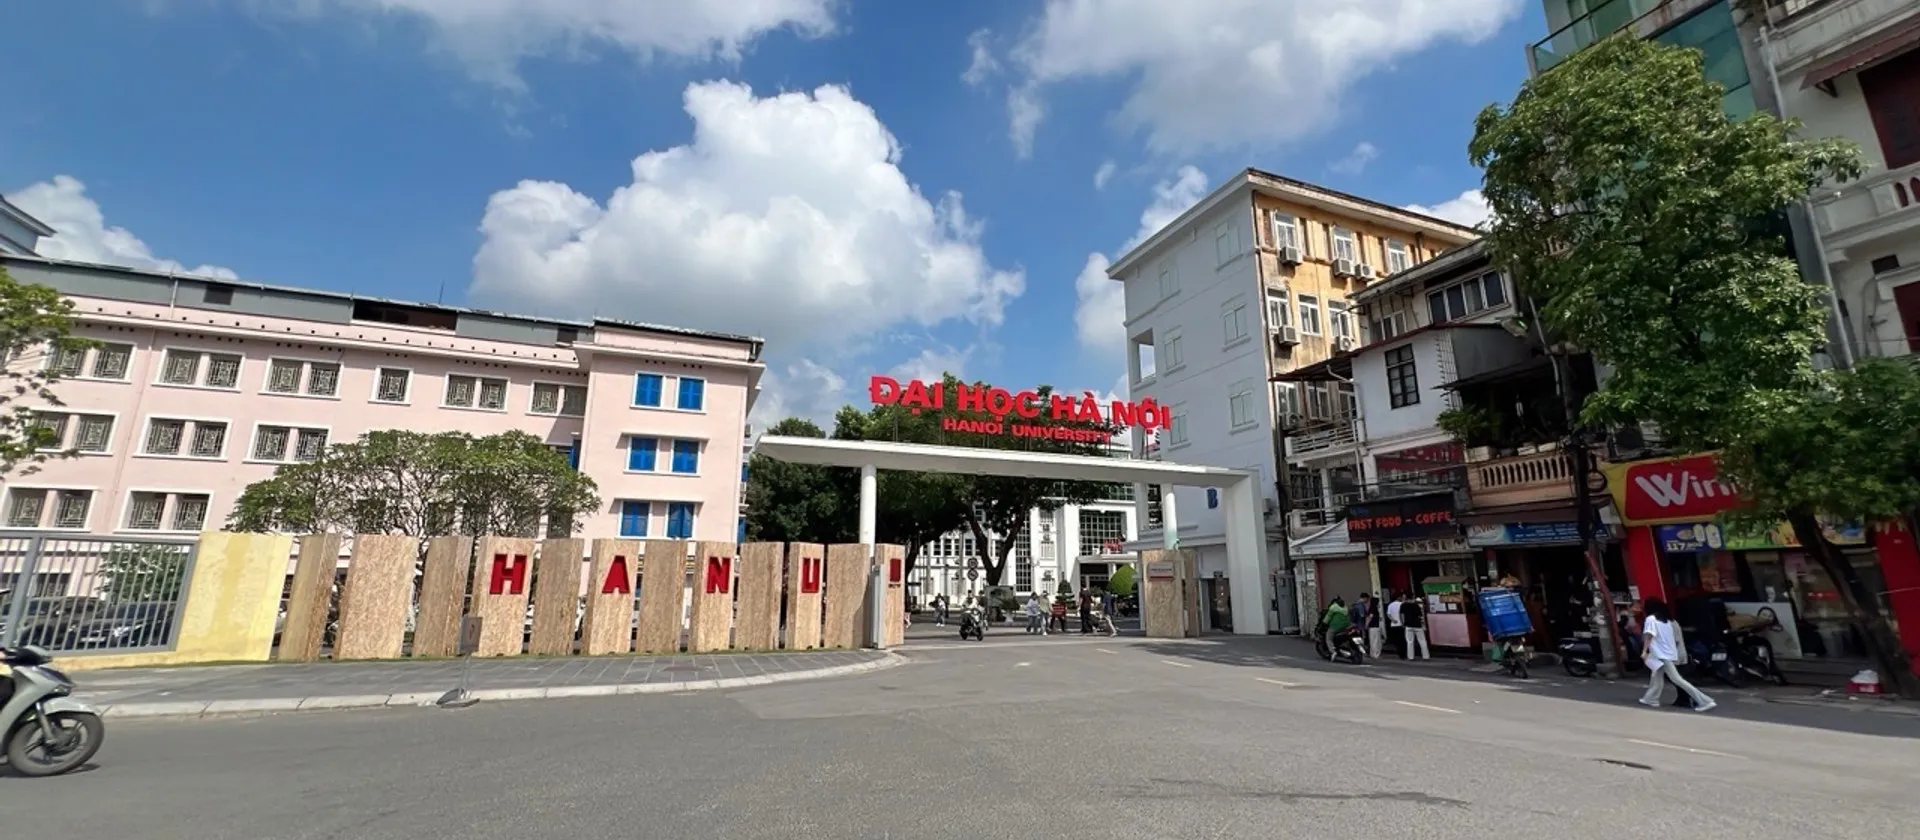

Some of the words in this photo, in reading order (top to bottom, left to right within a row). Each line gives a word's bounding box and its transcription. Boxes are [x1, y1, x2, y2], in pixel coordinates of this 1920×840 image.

[869, 375, 944, 413] ĐẠI
[956, 383, 1040, 421] HỌC
[1050, 391, 1103, 421] HÀ
[1111, 397, 1172, 434] NỘI
[943, 417, 1004, 435] HANOI
[1011, 425, 1110, 442] UNIVERSITY
[1206, 488, 1218, 509] B
[1375, 516, 1401, 527] FOOD
